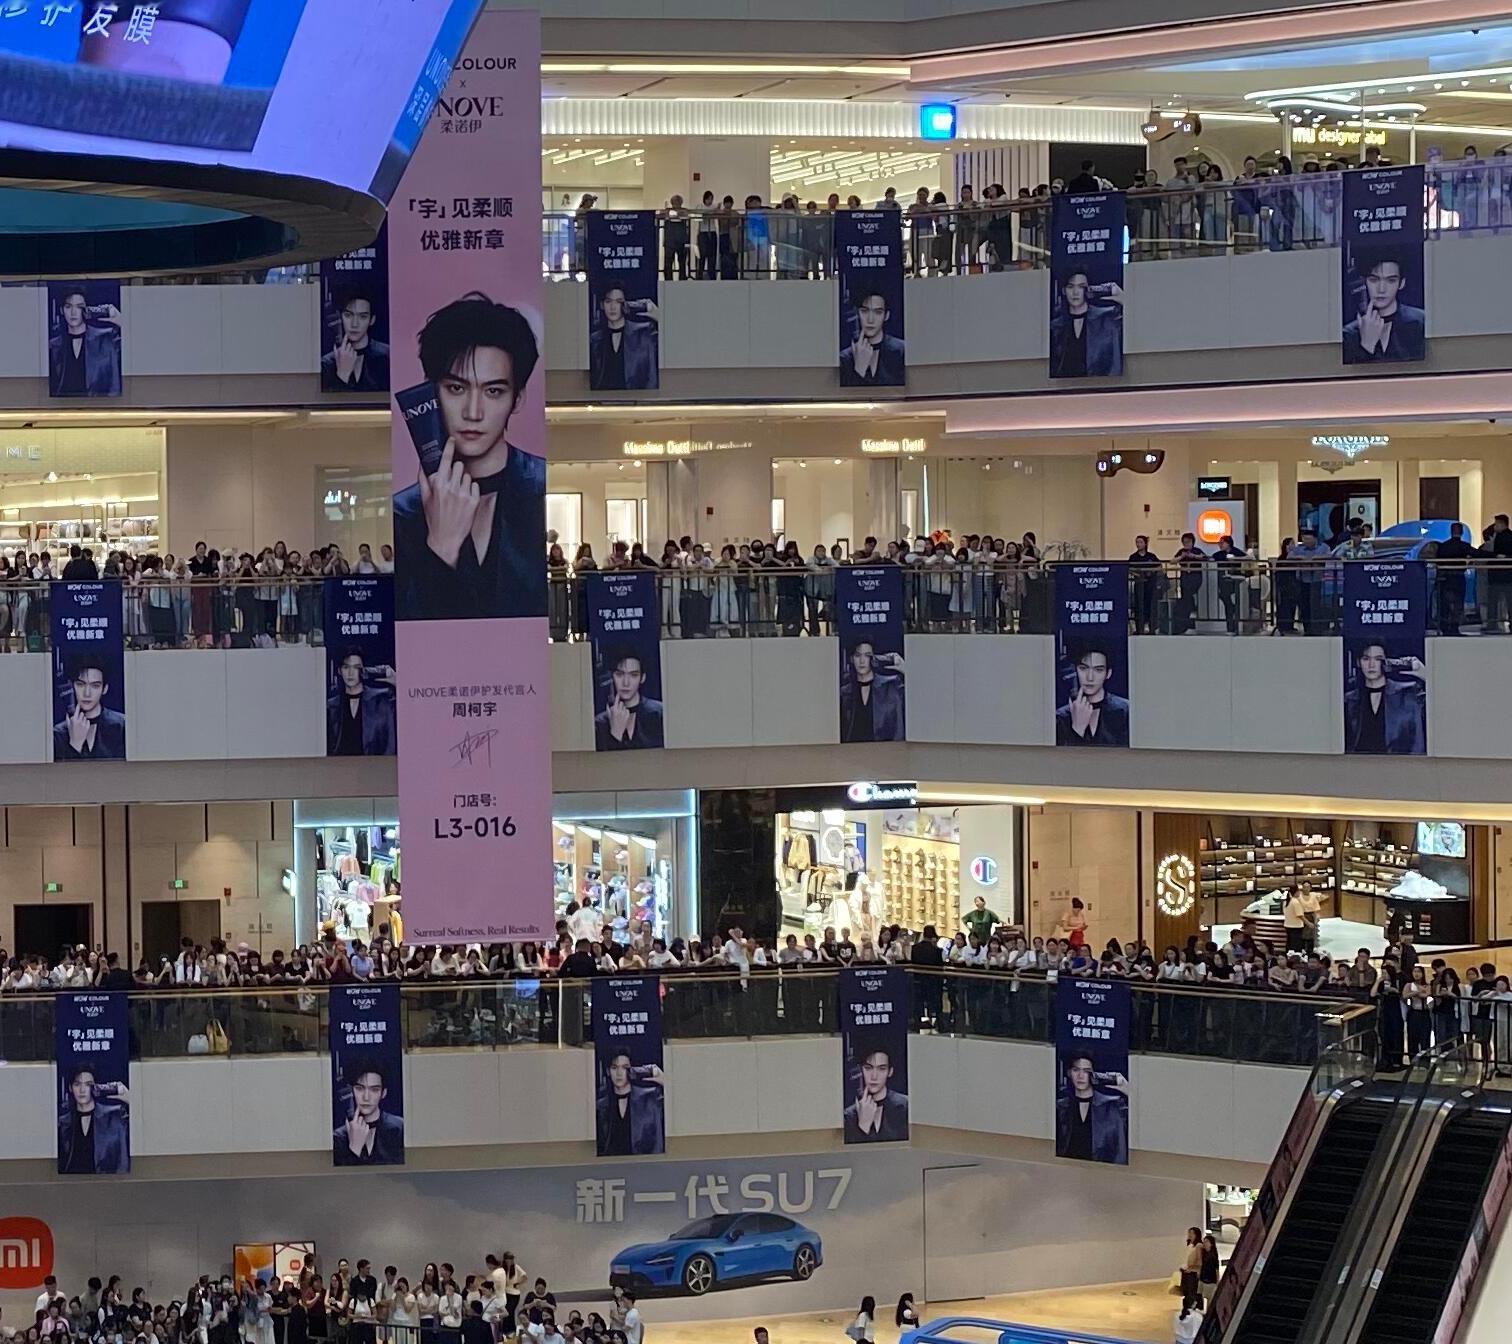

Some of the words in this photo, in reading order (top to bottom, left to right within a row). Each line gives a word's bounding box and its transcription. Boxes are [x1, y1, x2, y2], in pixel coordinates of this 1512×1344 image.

[438, 96, 504, 118] NOVE
[440, 119, 483, 135] 柔诺伊
[408, 197, 513, 219] 「宇」见柔顺
[420, 229, 505, 251] 优雅新章
[452, 701, 498, 718] 周柯宇
[434, 815, 517, 840] L3-016
